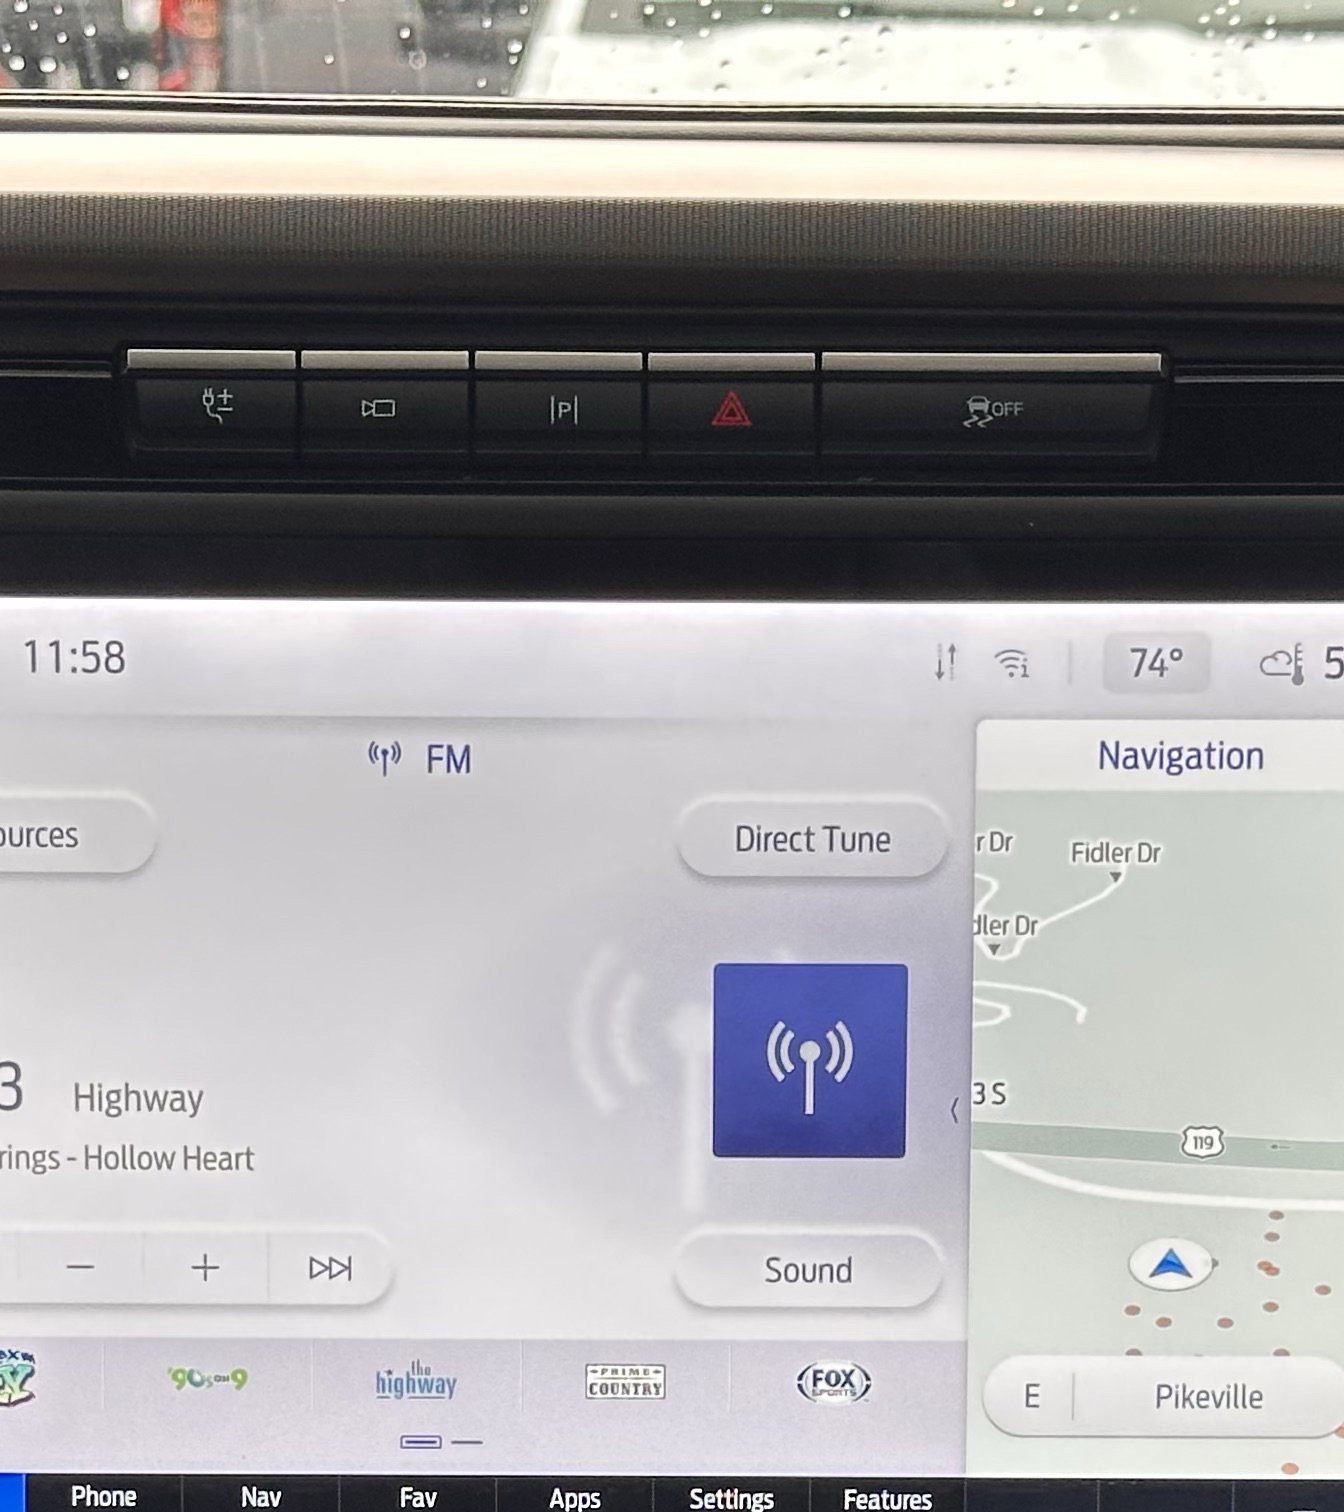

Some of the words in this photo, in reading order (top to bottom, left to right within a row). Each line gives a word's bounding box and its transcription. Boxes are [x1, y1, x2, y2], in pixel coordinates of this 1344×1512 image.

[991, 401, 1024, 417] OFF
[24, 639, 126, 674] 11:58
[1130, 647, 1184, 678] 74°
[427, 744, 471, 774] FM
[1099, 740, 1264, 777] Navigation
[736, 825, 816, 853] Direct
[822, 825, 891, 853] Tune
[989, 831, 1013, 851] Dr
[1071, 841, 1133, 863] Fidler
[1137, 842, 1161, 863] Dr
[1015, 914, 1039, 935] Dr
[74, 1082, 204, 1119] Highway
[1192, 1134, 1214, 1151] 119
[84, 1143, 177, 1171] Hollow
[183, 1144, 255, 1172] Heart
[765, 1255, 853, 1284] Sound
[411, 1358, 431, 1376] the
[600, 1368, 650, 1376] PRIME
[812, 1368, 856, 1388] FOX
[376, 1369, 457, 1400] highway
[589, 1382, 662, 1396] COUNTRY
[1025, 1383, 1041, 1409] E
[1156, 1383, 1263, 1410] Pikeville
[71, 1484, 137, 1507] Phone
[241, 1485, 282, 1508] Nav
[400, 1486, 438, 1508] Fav
[549, 1487, 602, 1512] Apps
[844, 1488, 933, 1511] Features
